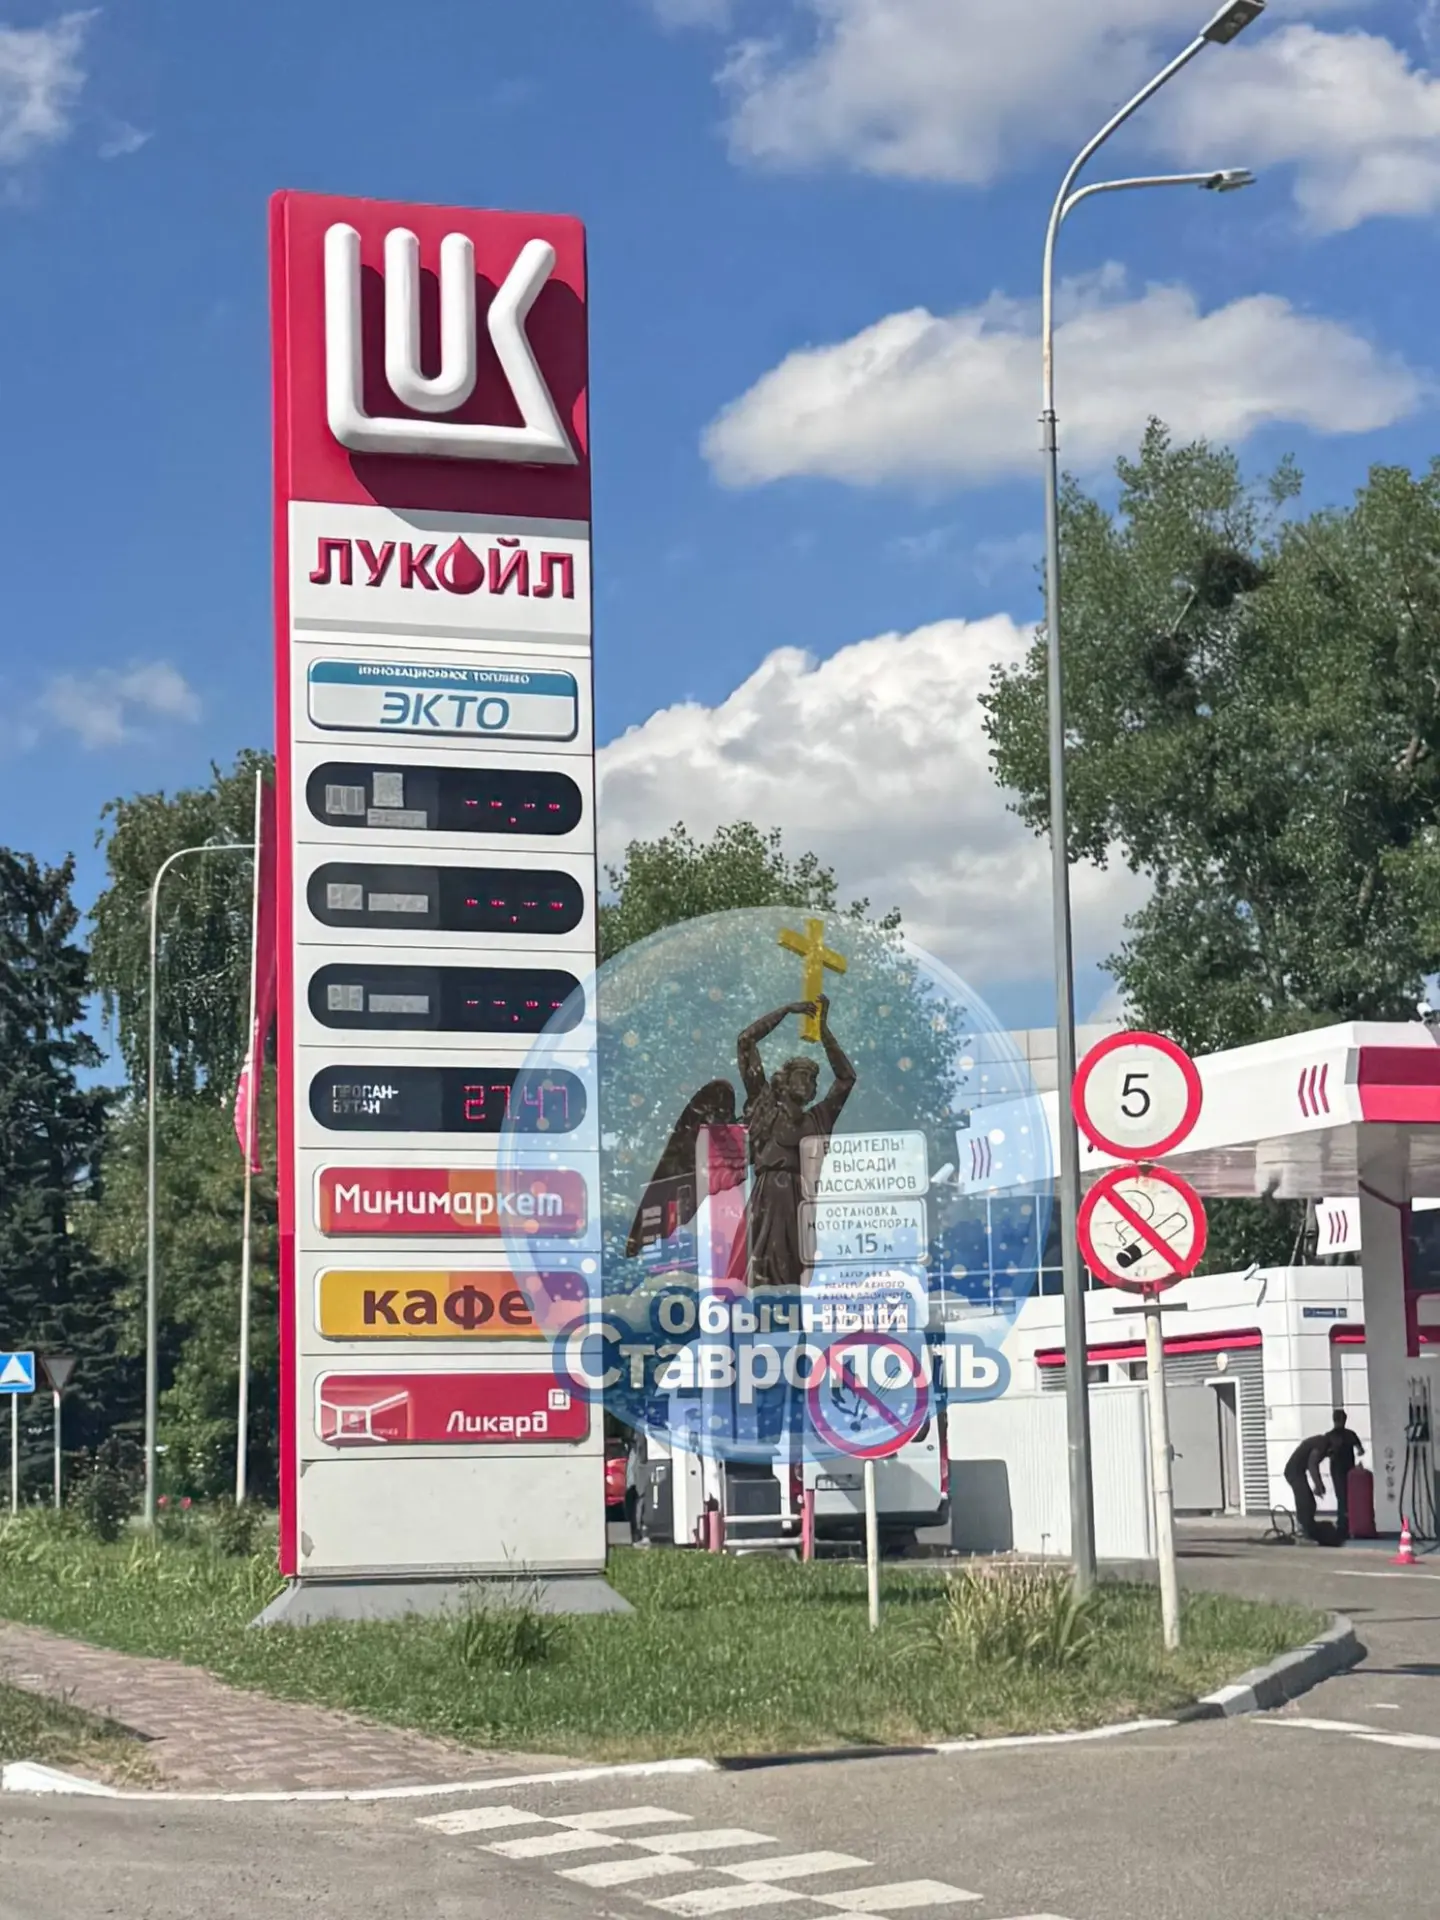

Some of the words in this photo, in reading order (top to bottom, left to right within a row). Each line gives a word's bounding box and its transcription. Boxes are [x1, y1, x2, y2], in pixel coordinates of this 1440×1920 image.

[309, 535, 575, 600] ЛУКОЙЛ
[380, 691, 510, 730] ЭКТО
[332, 1100, 381, 1115] БУТАН
[1121, 1073, 1151, 1118] 5
[823, 1138, 905, 1155] ВОДИТЕЛЬ!
[833, 1157, 897, 1173] ВЫСАДИ
[814, 1176, 917, 1193] ПАССАЖИРОВ
[334, 1183, 563, 1224] Минимаркет
[826, 1205, 898, 1218] ОСТАНОВКА
[807, 1218, 919, 1232] МОТОТРАНСПОРТА
[836, 1244, 852, 1256] ЗА
[854, 1232, 879, 1255] 15
[363, 1285, 535, 1331] кафе
[446, 1410, 548, 1437] Ликард
